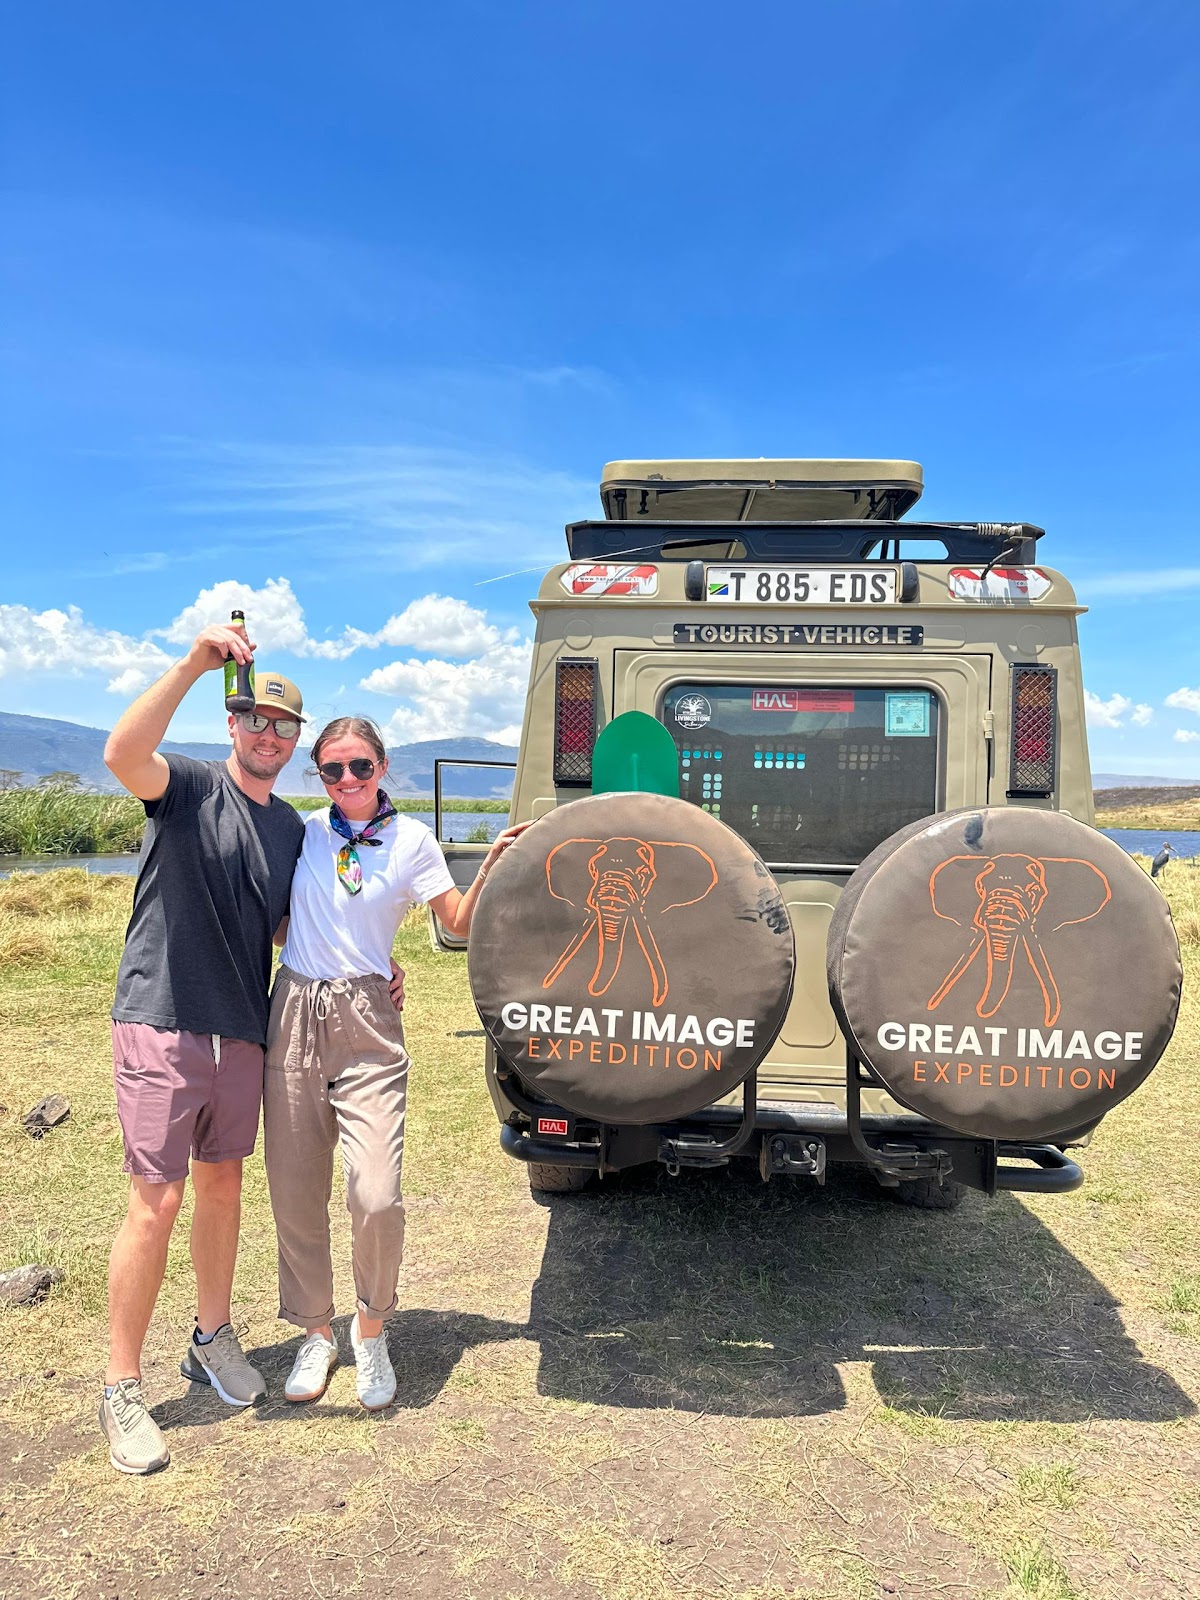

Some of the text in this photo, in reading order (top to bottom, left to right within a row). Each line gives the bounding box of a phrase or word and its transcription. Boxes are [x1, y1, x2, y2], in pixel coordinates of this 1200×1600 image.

[730, 572, 888, 603] T 885 EDS
[685, 625, 912, 645] TOURIST VEHICLE
[755, 693, 793, 708] HAL
[501, 1002, 756, 1048] GREAT IMAGE
[527, 1036, 723, 1072] EXPEDITION
[877, 1021, 1144, 1061] GREAT IMAGE
[912, 1060, 1117, 1090] EXPEDITION
[541, 1121, 565, 1132] HAL
